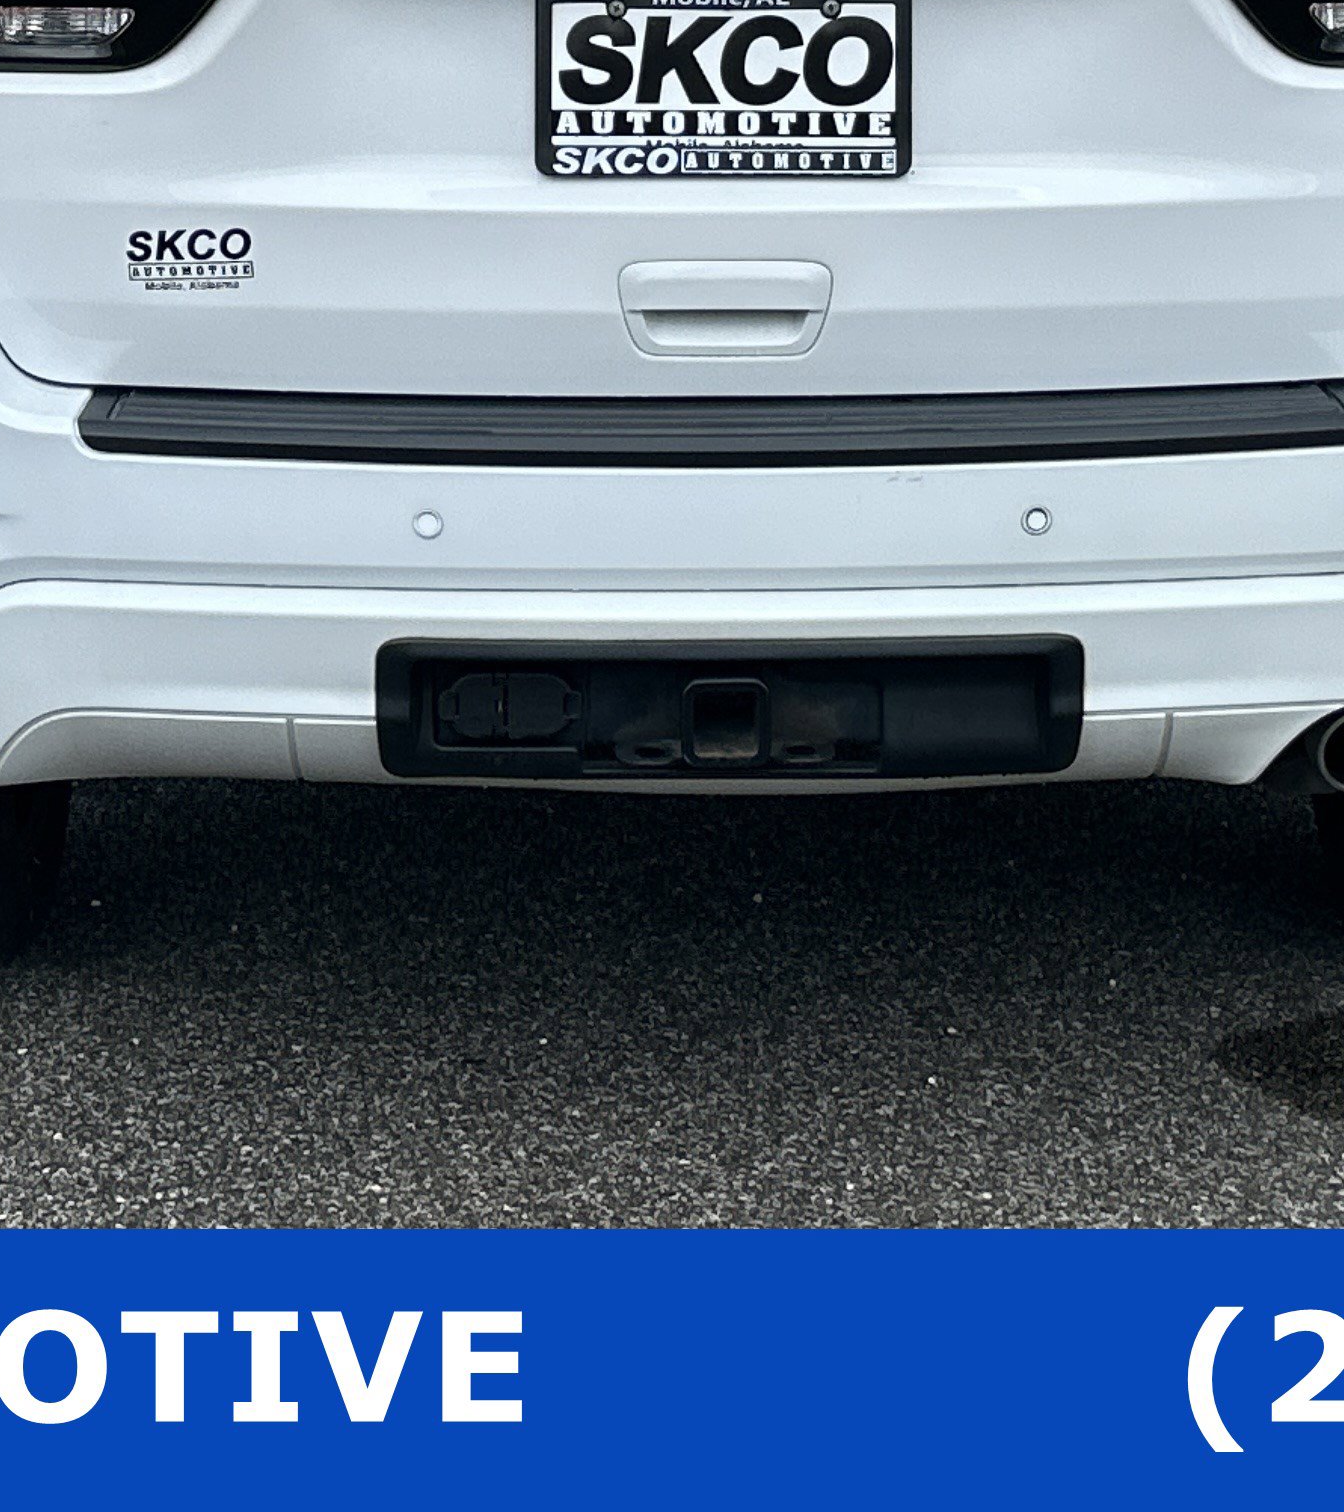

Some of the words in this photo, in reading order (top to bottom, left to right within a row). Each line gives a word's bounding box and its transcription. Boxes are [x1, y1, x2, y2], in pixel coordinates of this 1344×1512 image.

[558, 14, 894, 107] SKCO
[555, 110, 893, 136] AUTOMOTIVE
[552, 146, 680, 175] SKCO
[684, 150, 895, 171] AUTOMOTIVE
[126, 227, 252, 262] SKCO
[131, 264, 253, 278] AUTOMOTIVE
